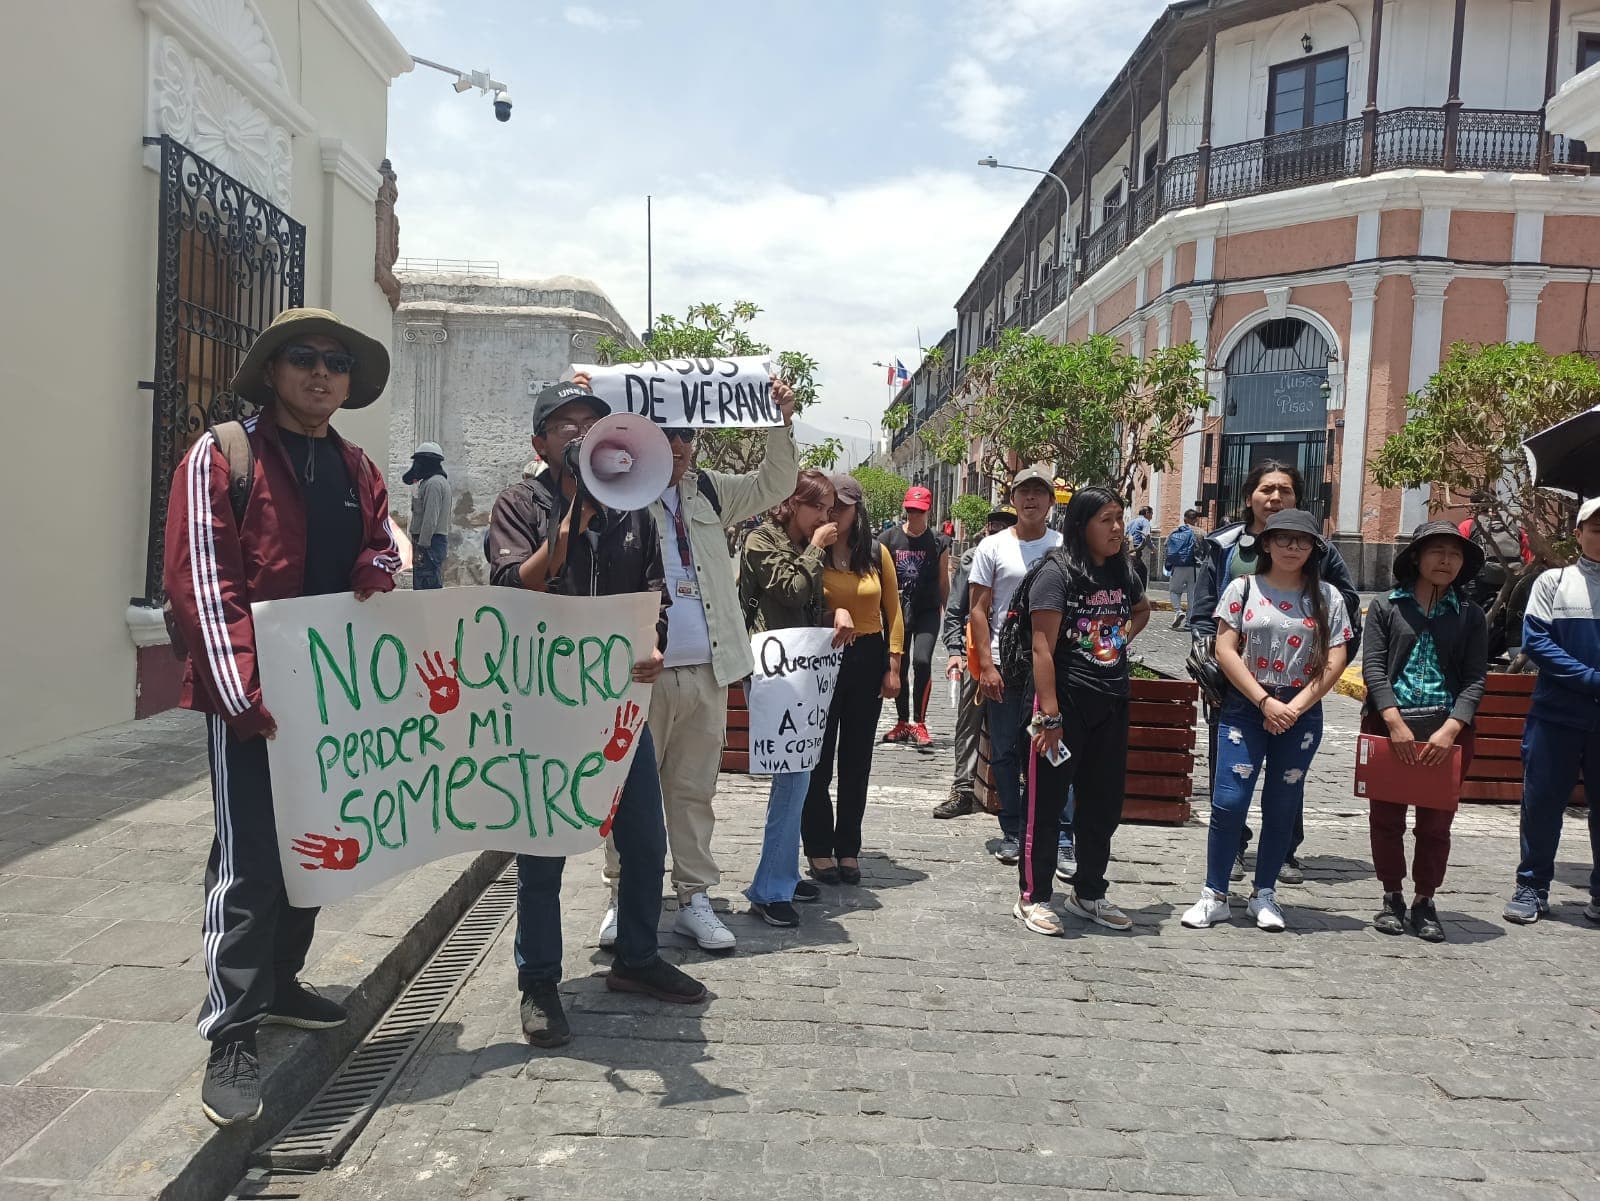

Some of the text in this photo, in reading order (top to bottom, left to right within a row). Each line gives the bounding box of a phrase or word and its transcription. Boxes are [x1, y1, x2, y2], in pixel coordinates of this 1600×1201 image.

[625, 374, 667, 423] DE
[307, 622, 408, 725] NO
[761, 636, 845, 677] Queremos
[469, 703, 513, 747] Mi
[778, 709, 798, 735] A
[754, 739, 775, 755] ME
[760, 760, 790, 771] VIVA
